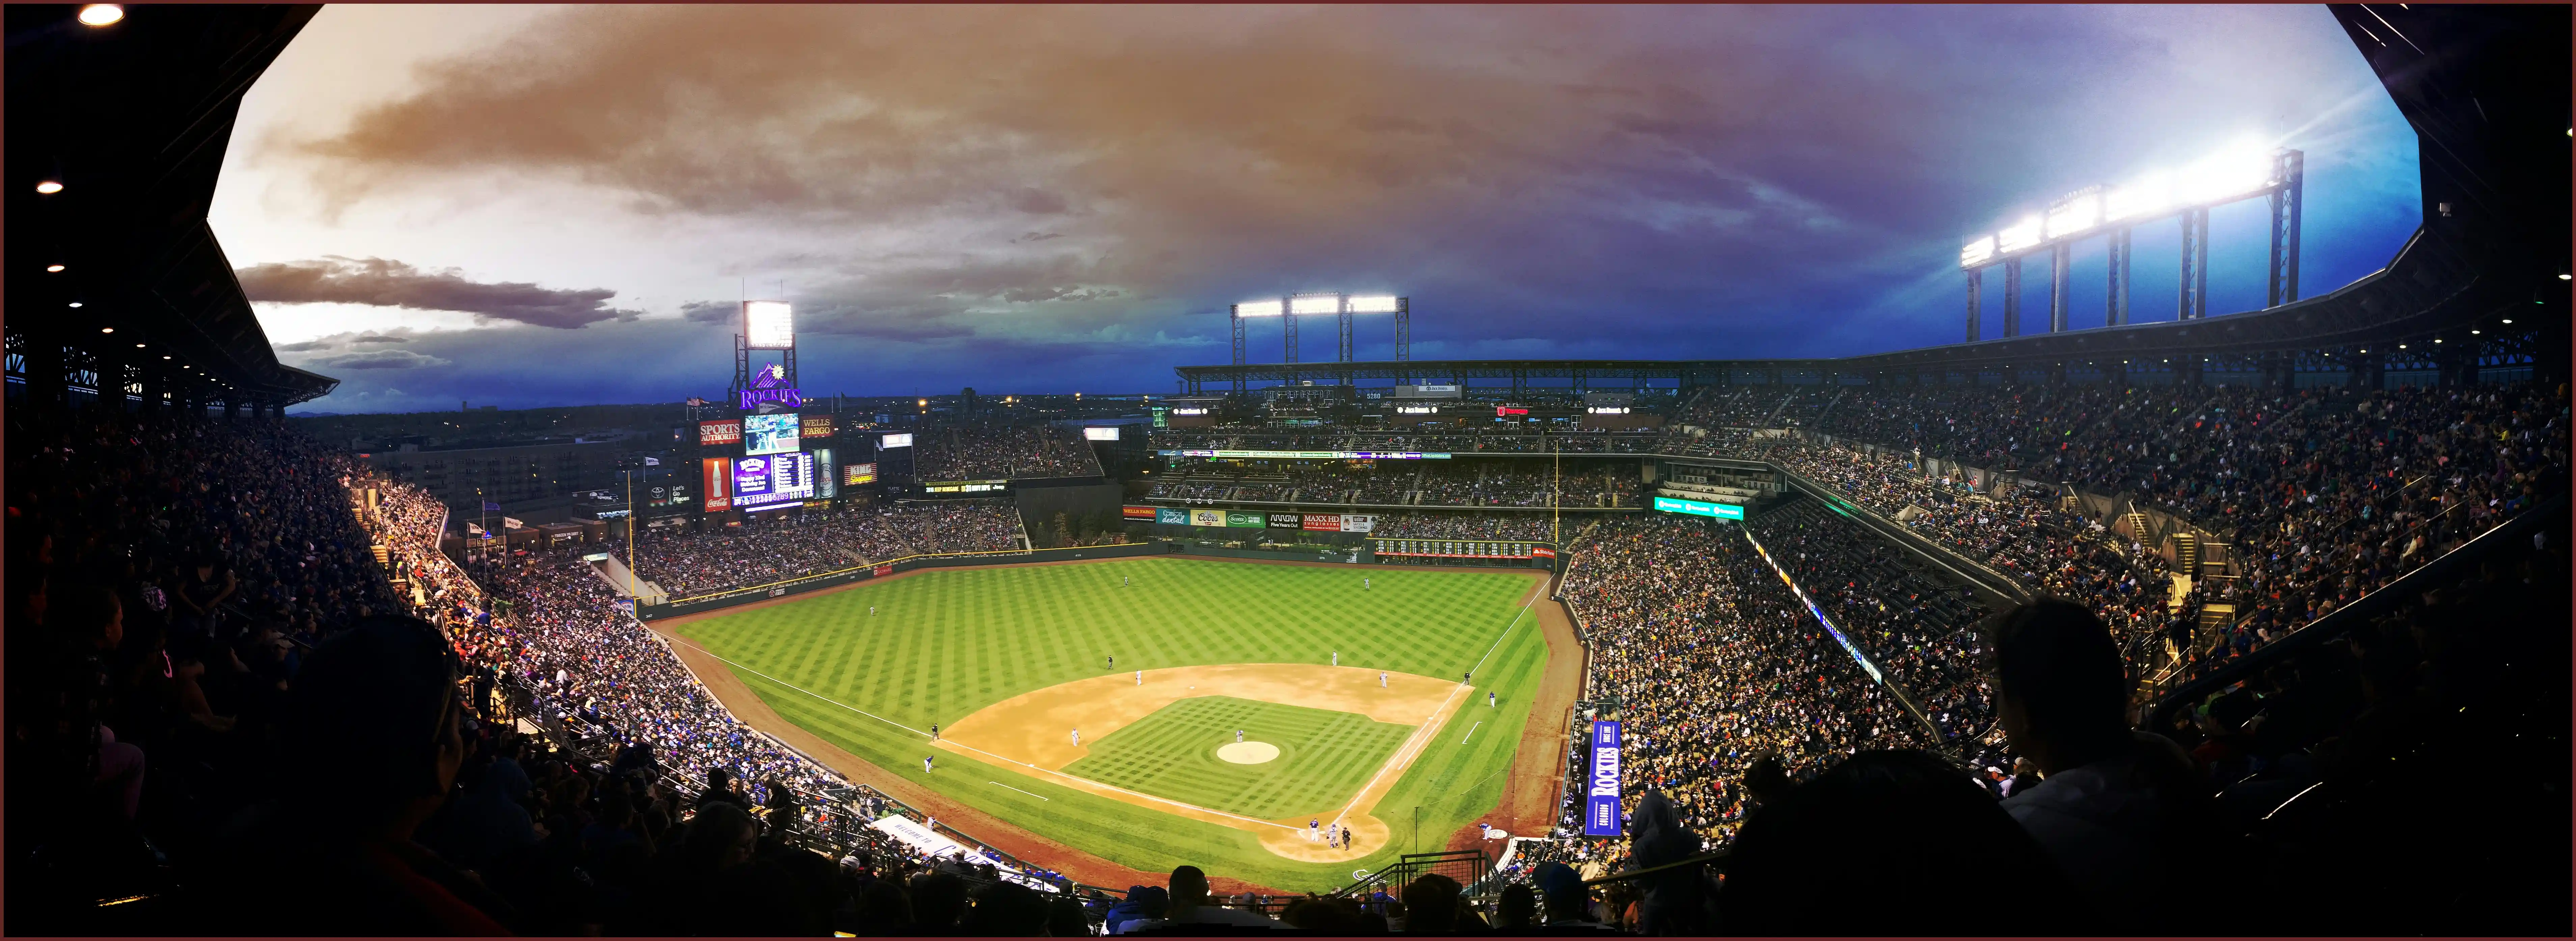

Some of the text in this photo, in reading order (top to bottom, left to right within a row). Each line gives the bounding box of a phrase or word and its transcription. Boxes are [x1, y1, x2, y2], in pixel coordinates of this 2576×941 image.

[739, 389, 802, 410] ROCKIES
[1262, 391, 1280, 399] THE
[700, 423, 740, 435] SPORTS
[804, 427, 830, 435] FARGO
[850, 465, 871, 475] KING
[1162, 515, 1184, 524] dental
[1198, 513, 1218, 522] Coors
[1603, 734, 1611, 742] SINCE
[1591, 747, 1619, 797] ROCKIES
[1599, 804, 1609, 826] COLORADO
[894, 824, 921, 839] WELCOME
